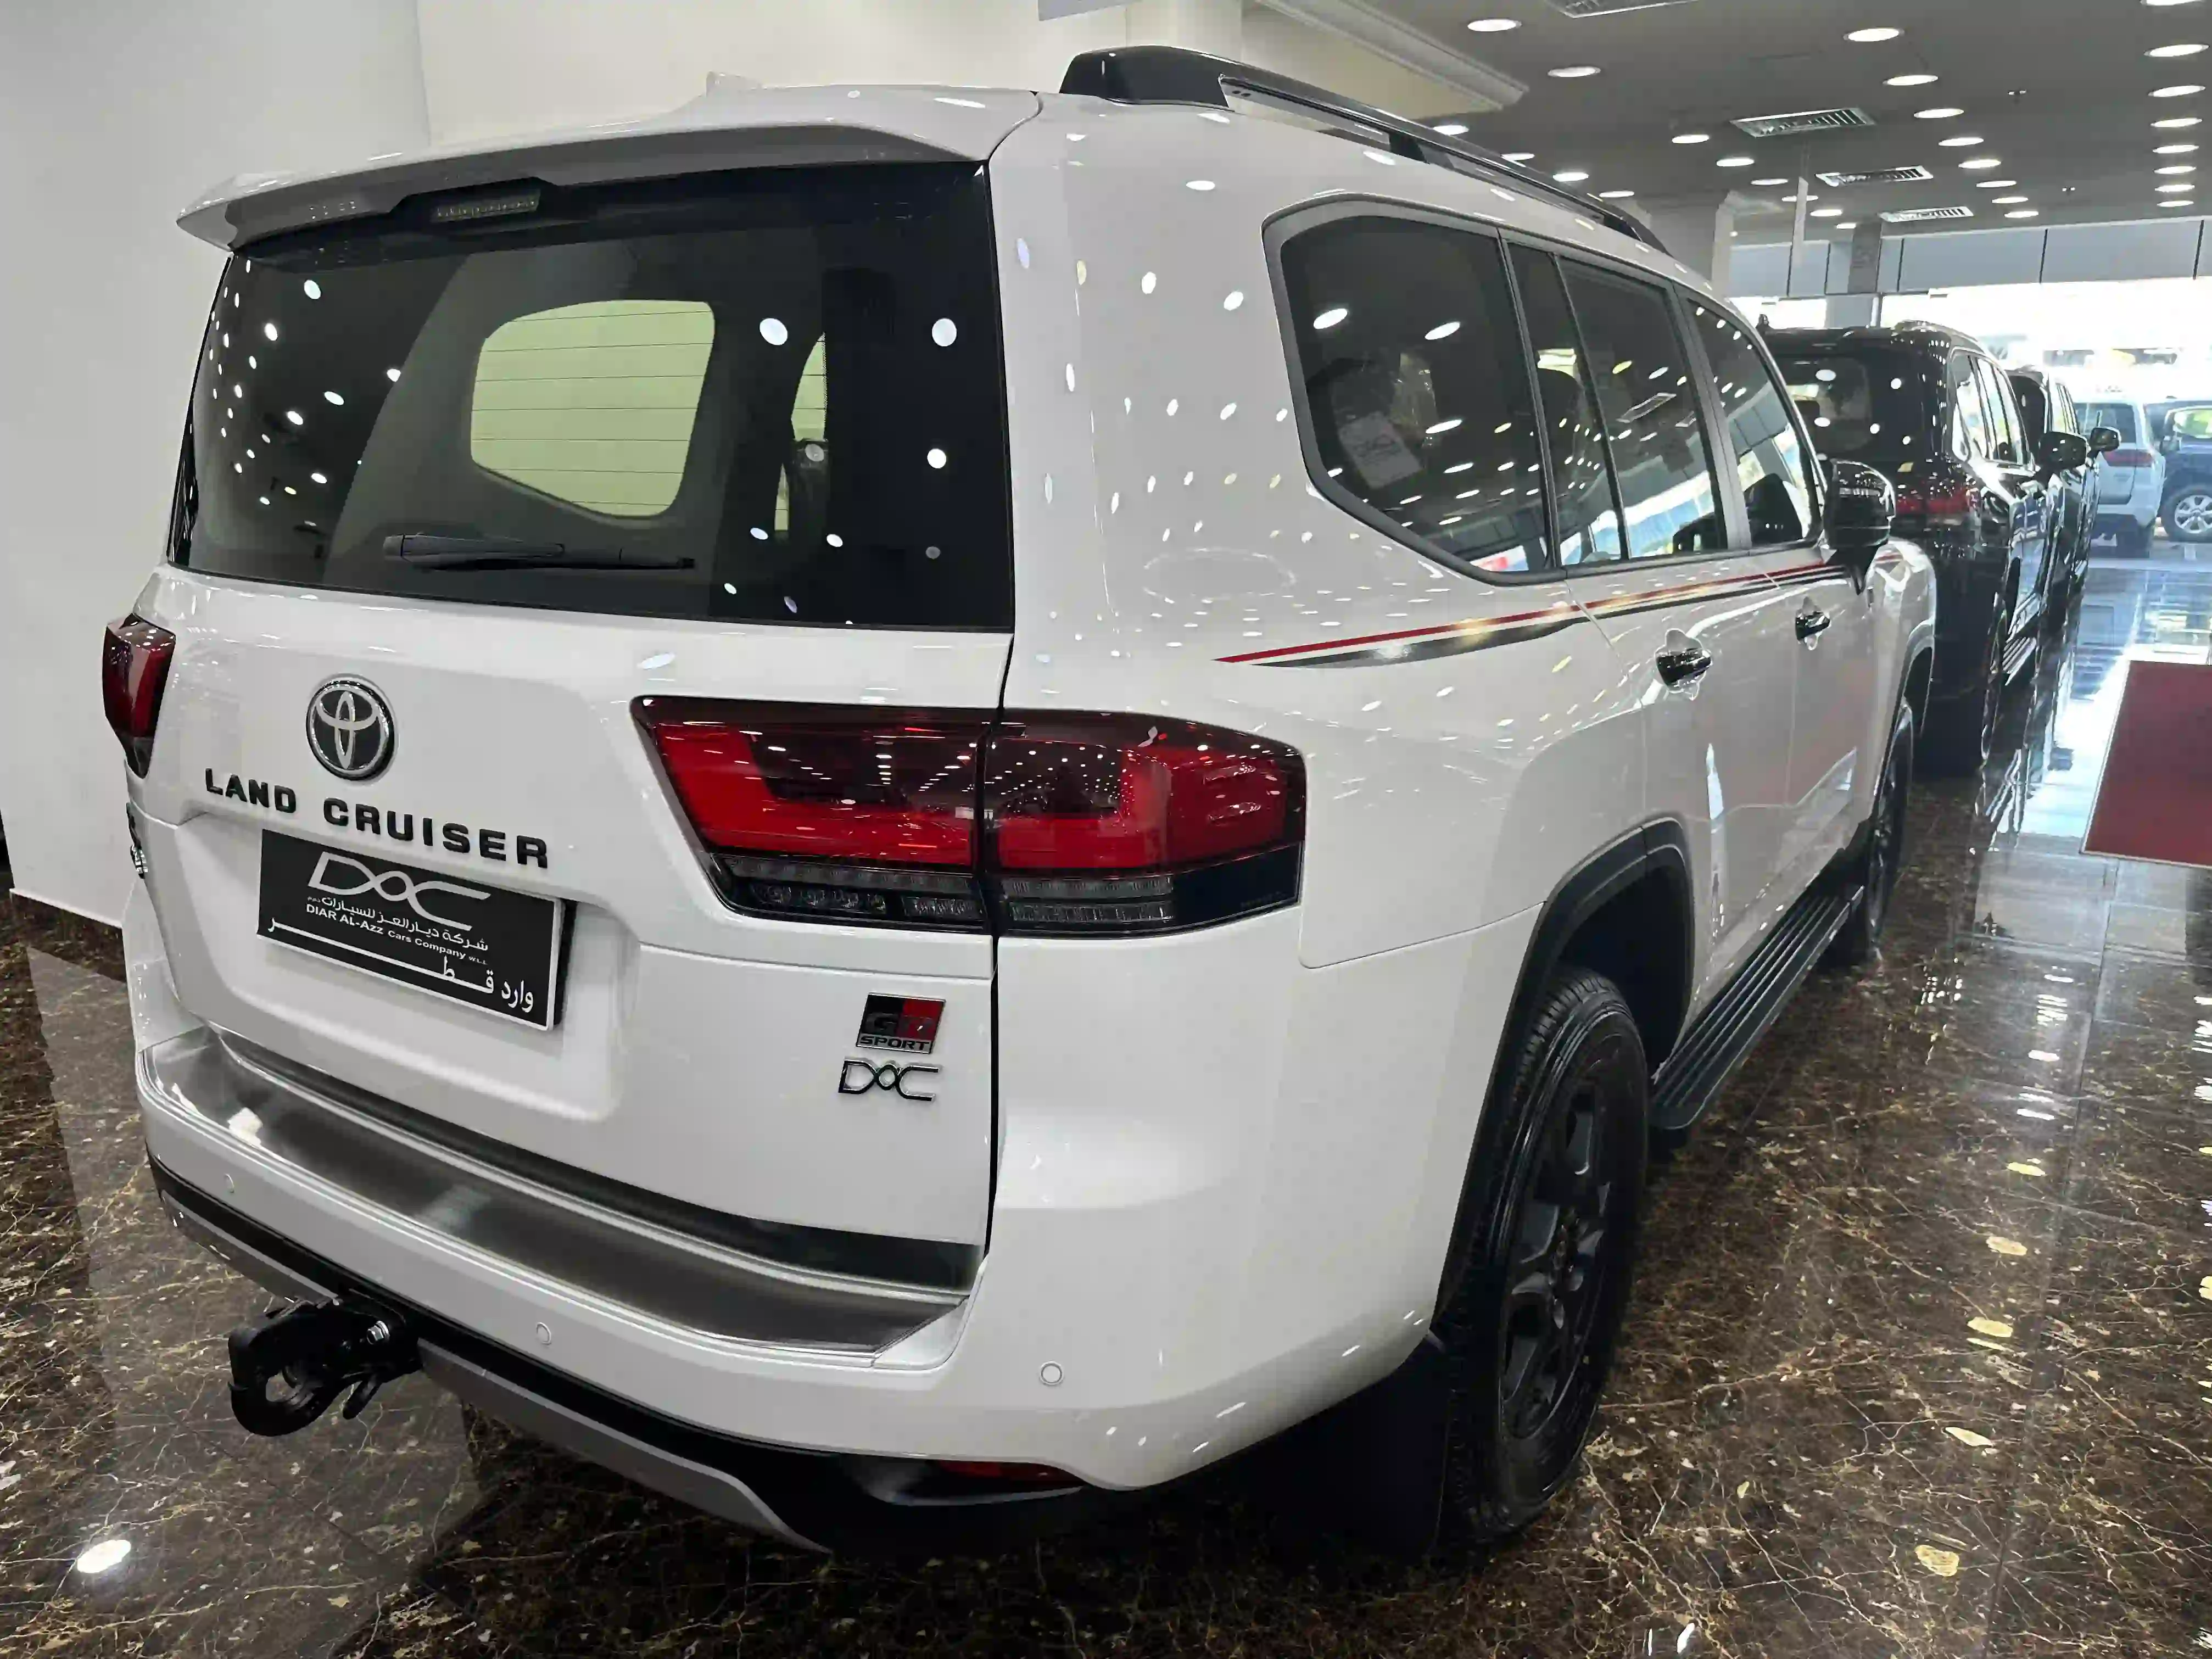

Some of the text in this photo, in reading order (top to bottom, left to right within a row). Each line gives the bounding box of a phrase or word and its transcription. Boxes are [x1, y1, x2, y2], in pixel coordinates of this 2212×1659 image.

[205, 767, 548, 869] LAND CRUISER
[321, 897, 376, 919] للسيارات
[306, 903, 337, 920] DIAR
[388, 930, 412, 943] Cars
[415, 938, 466, 960] Company
[408, 921, 439, 938] ديار
[443, 929, 488, 951] شركة
[268, 917, 534, 1013] وارد قطر
[860, 1036, 930, 1051] SPORT
